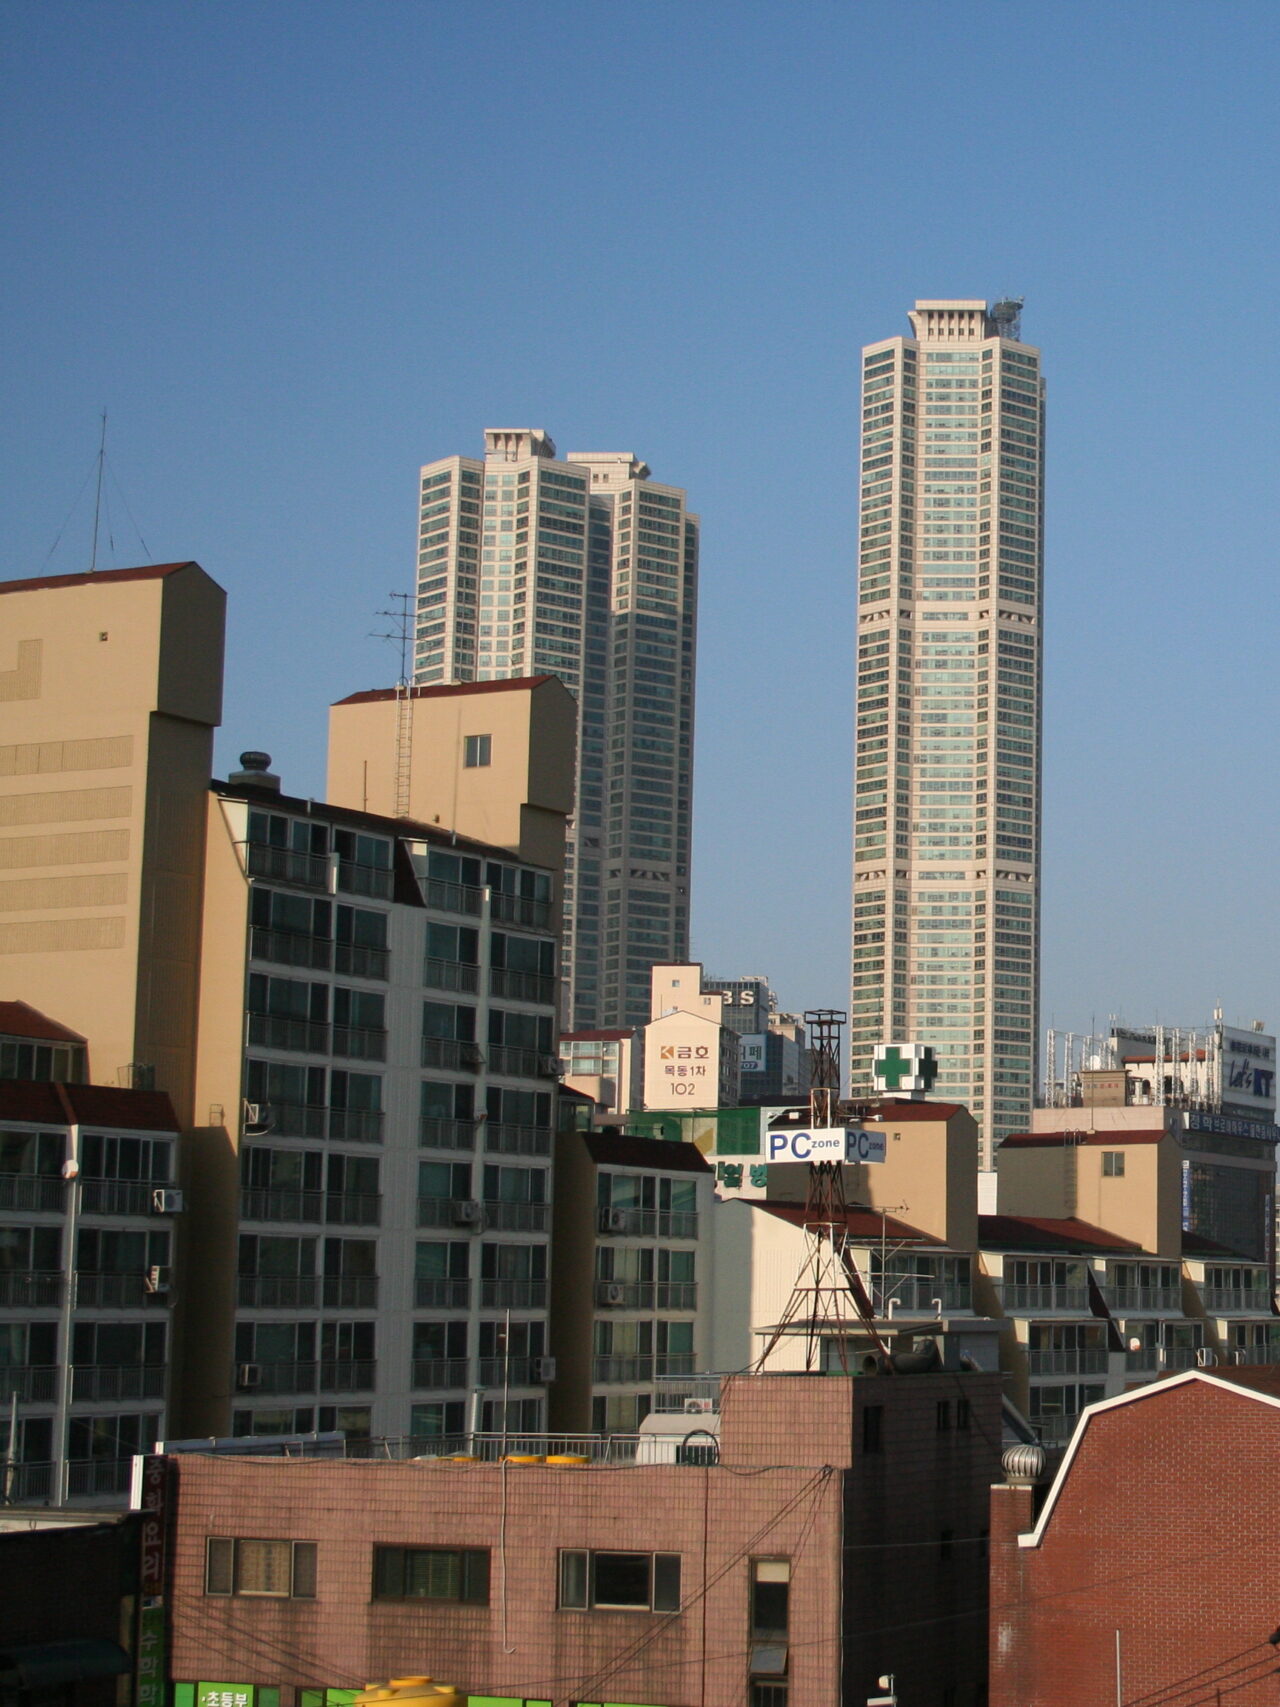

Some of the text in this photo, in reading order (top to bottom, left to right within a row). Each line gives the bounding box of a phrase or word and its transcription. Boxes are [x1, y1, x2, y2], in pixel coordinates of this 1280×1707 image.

[677, 1046, 709, 1059] 금호
[670, 1083, 695, 1095] 102
[770, 1133, 840, 1160] PC zone
